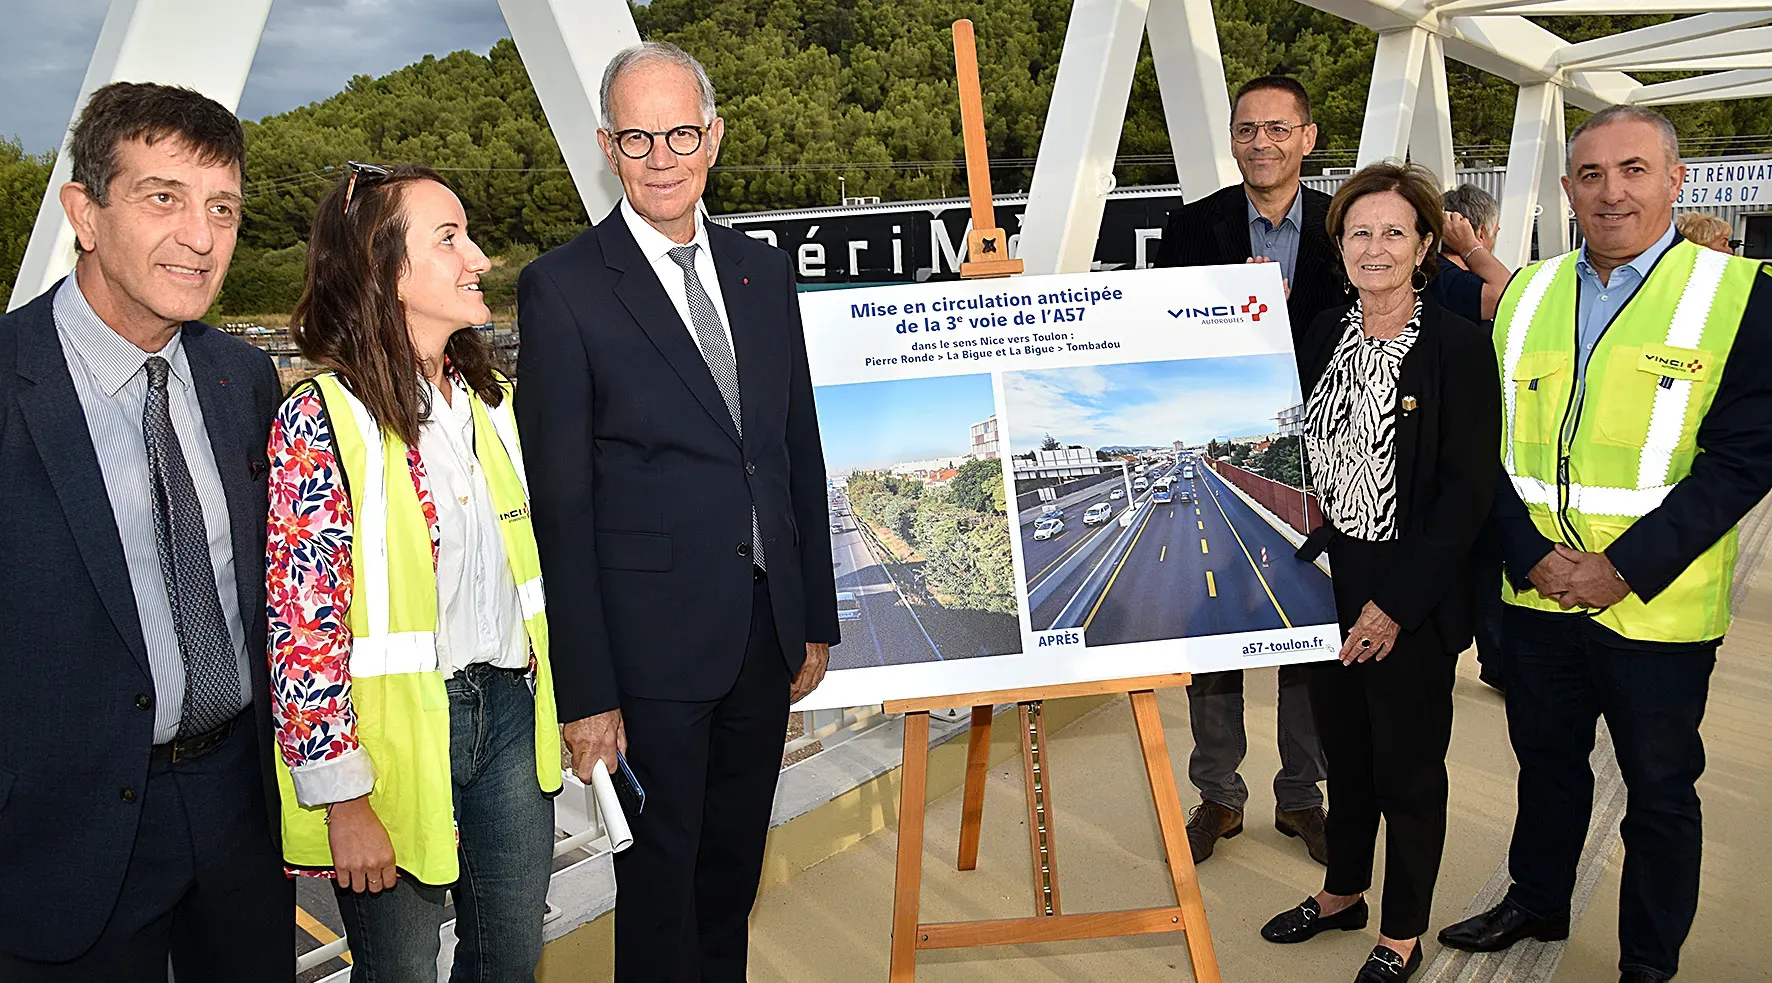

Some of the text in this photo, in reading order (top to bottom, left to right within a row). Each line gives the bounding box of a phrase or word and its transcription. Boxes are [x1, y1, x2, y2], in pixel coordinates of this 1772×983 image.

[1684, 168, 1700, 183] ET
[1691, 188, 1708, 203] 57
[1715, 187, 1733, 203] 48
[1741, 186, 1758, 202] 07
[851, 286, 1123, 319] Mise en circulation anticipée
[1167, 305, 1235, 319] VINCI
[1201, 316, 1244, 325] AUTOROUTES
[896, 319, 919, 334] de
[924, 317, 941, 332] la
[969, 312, 1008, 329] voie
[1013, 310, 1036, 326] de
[911, 341, 937, 351] dans
[940, 340, 950, 349] le
[953, 338, 978, 348] sens
[980, 336, 1005, 346] Nice
[1007, 334, 1030, 345] vers
[1032, 332, 1068, 342] Toulon
[865, 357, 898, 366] Pierre
[901, 352, 935, 364] Ronde
[947, 351, 959, 361] La
[962, 348, 993, 361] Bigue
[995, 348, 1007, 357] et
[1009, 346, 1022, 356] La
[1024, 344, 1055, 356] Bigue
[1066, 340, 1121, 352] Tombadou
[1645, 354, 1684, 368] VINCI
[500, 508, 522, 520] INCI
[1038, 630, 1080, 648] APRÈS
[1242, 636, 1324, 655] a57-toulon.fr
